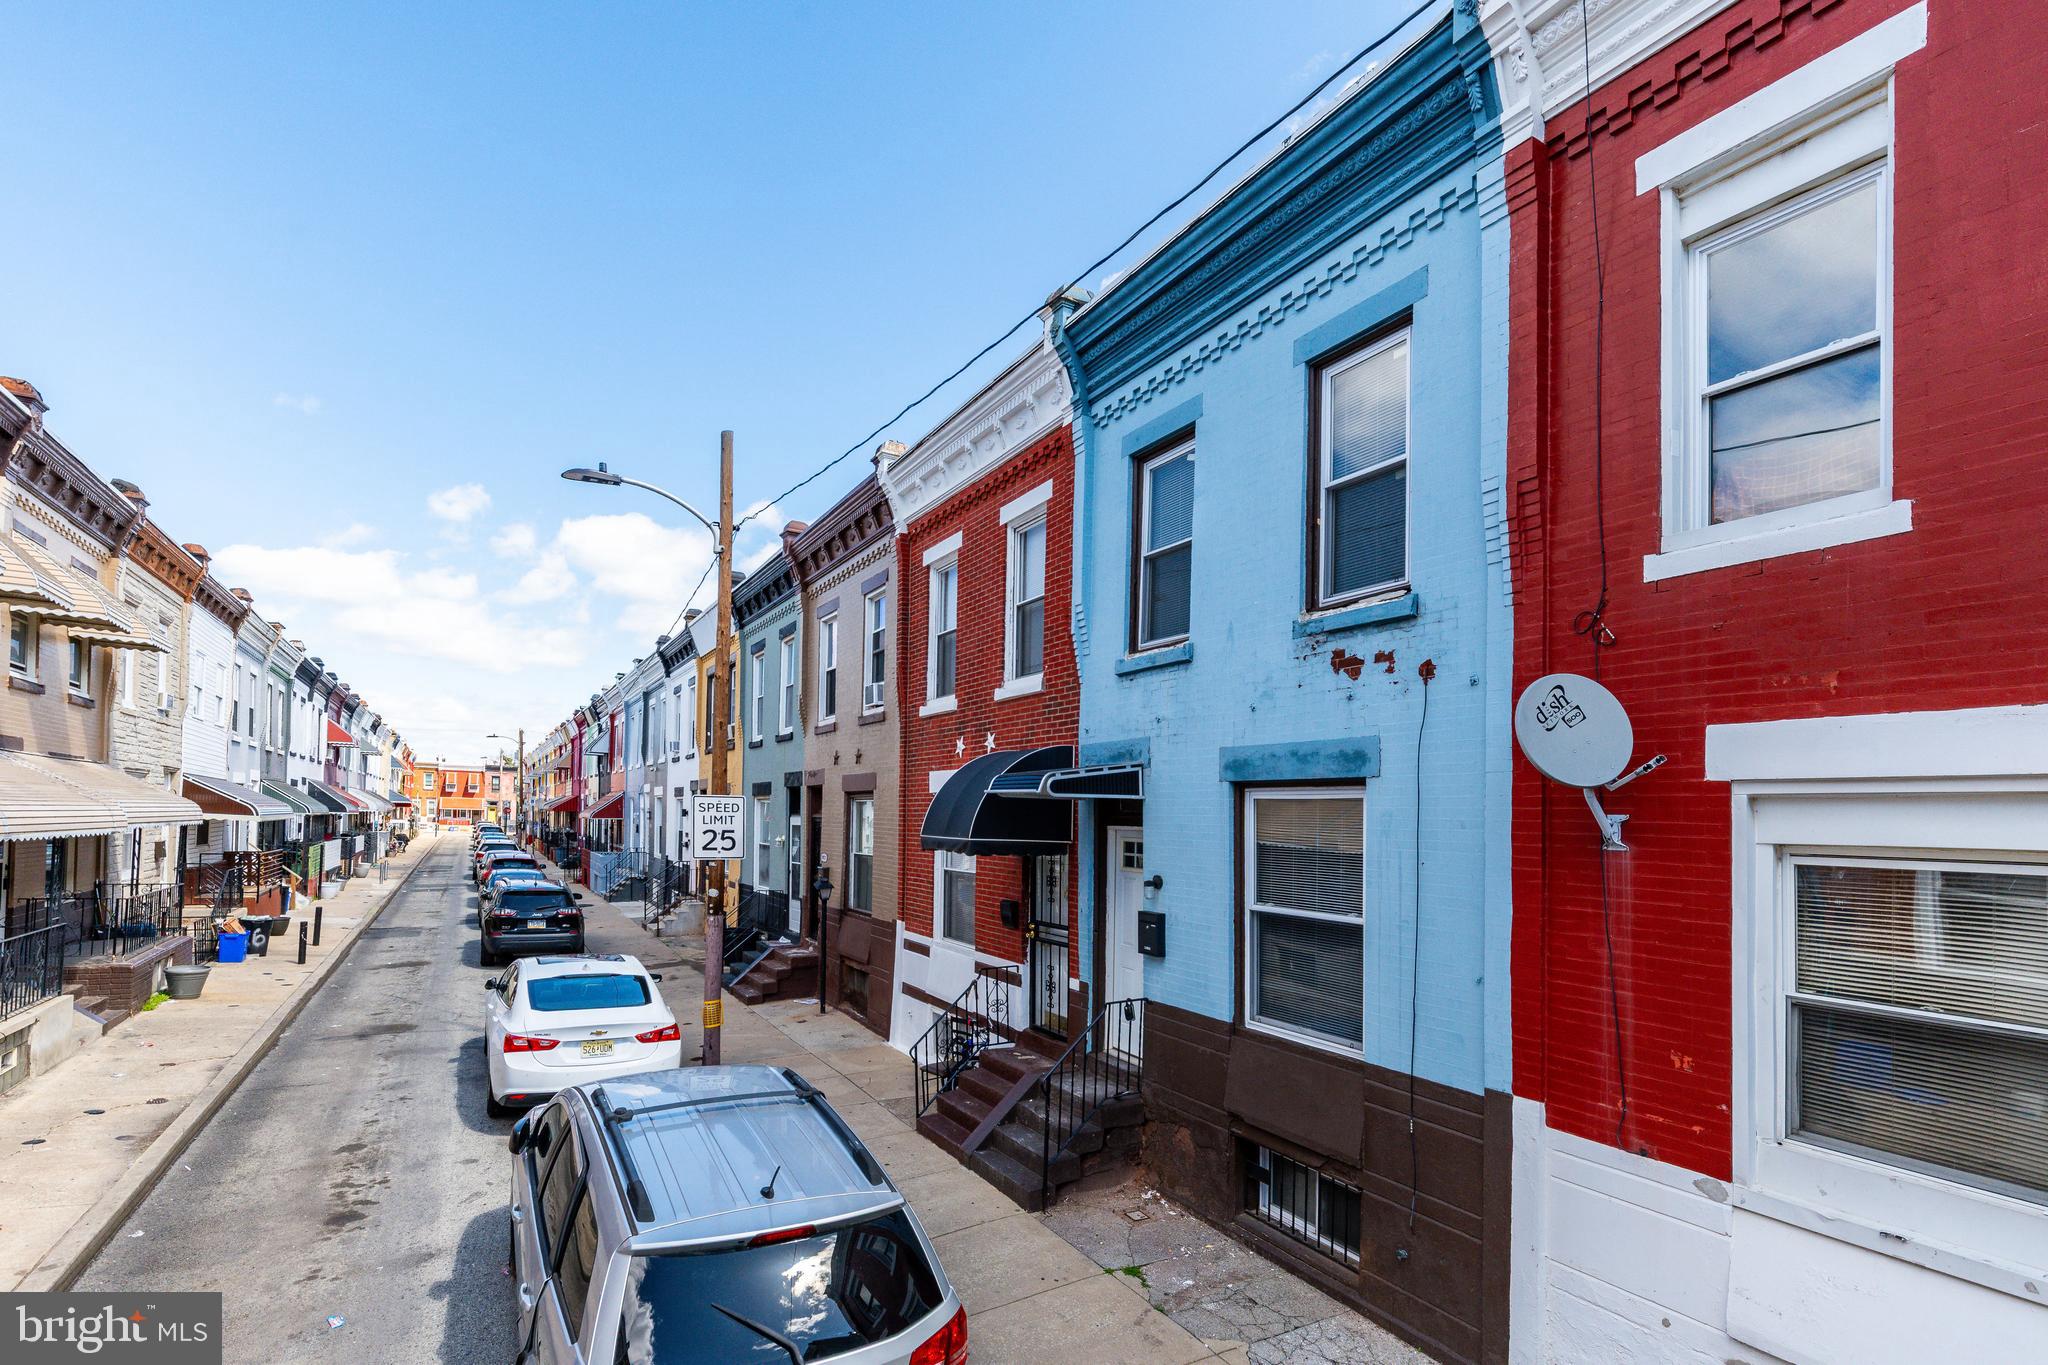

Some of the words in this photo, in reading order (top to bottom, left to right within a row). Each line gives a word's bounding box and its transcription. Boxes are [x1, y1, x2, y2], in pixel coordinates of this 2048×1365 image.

[1536, 693, 1571, 724] dish
[1566, 711, 1581, 724] 500
[698, 802, 740, 813] SPEED
[702, 815, 736, 825] LIMIT
[701, 829, 737, 851] 25
[252, 927, 266, 947] 6
